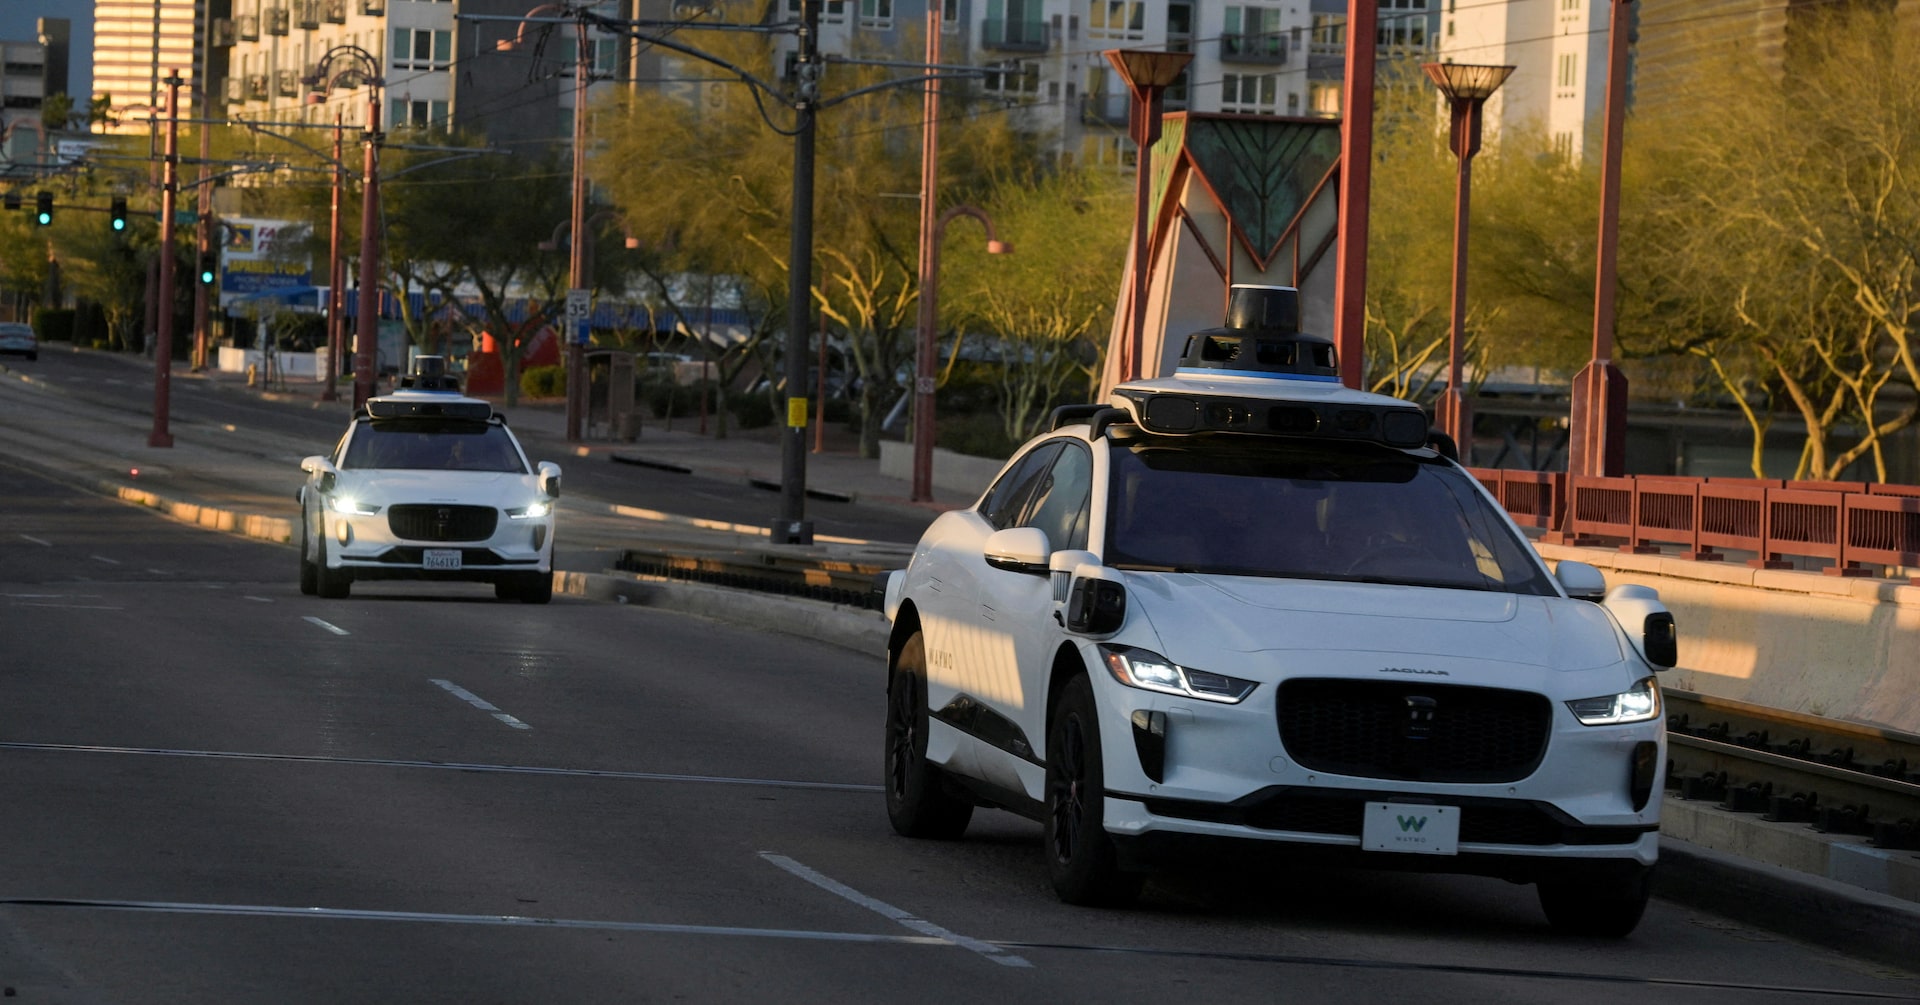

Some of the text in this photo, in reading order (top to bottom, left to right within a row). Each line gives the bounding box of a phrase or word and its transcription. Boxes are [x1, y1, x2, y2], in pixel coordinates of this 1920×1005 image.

[569, 303, 588, 317] 35
[929, 648, 952, 670] WAYMO
[1379, 667, 1449, 676] JAGUAR
